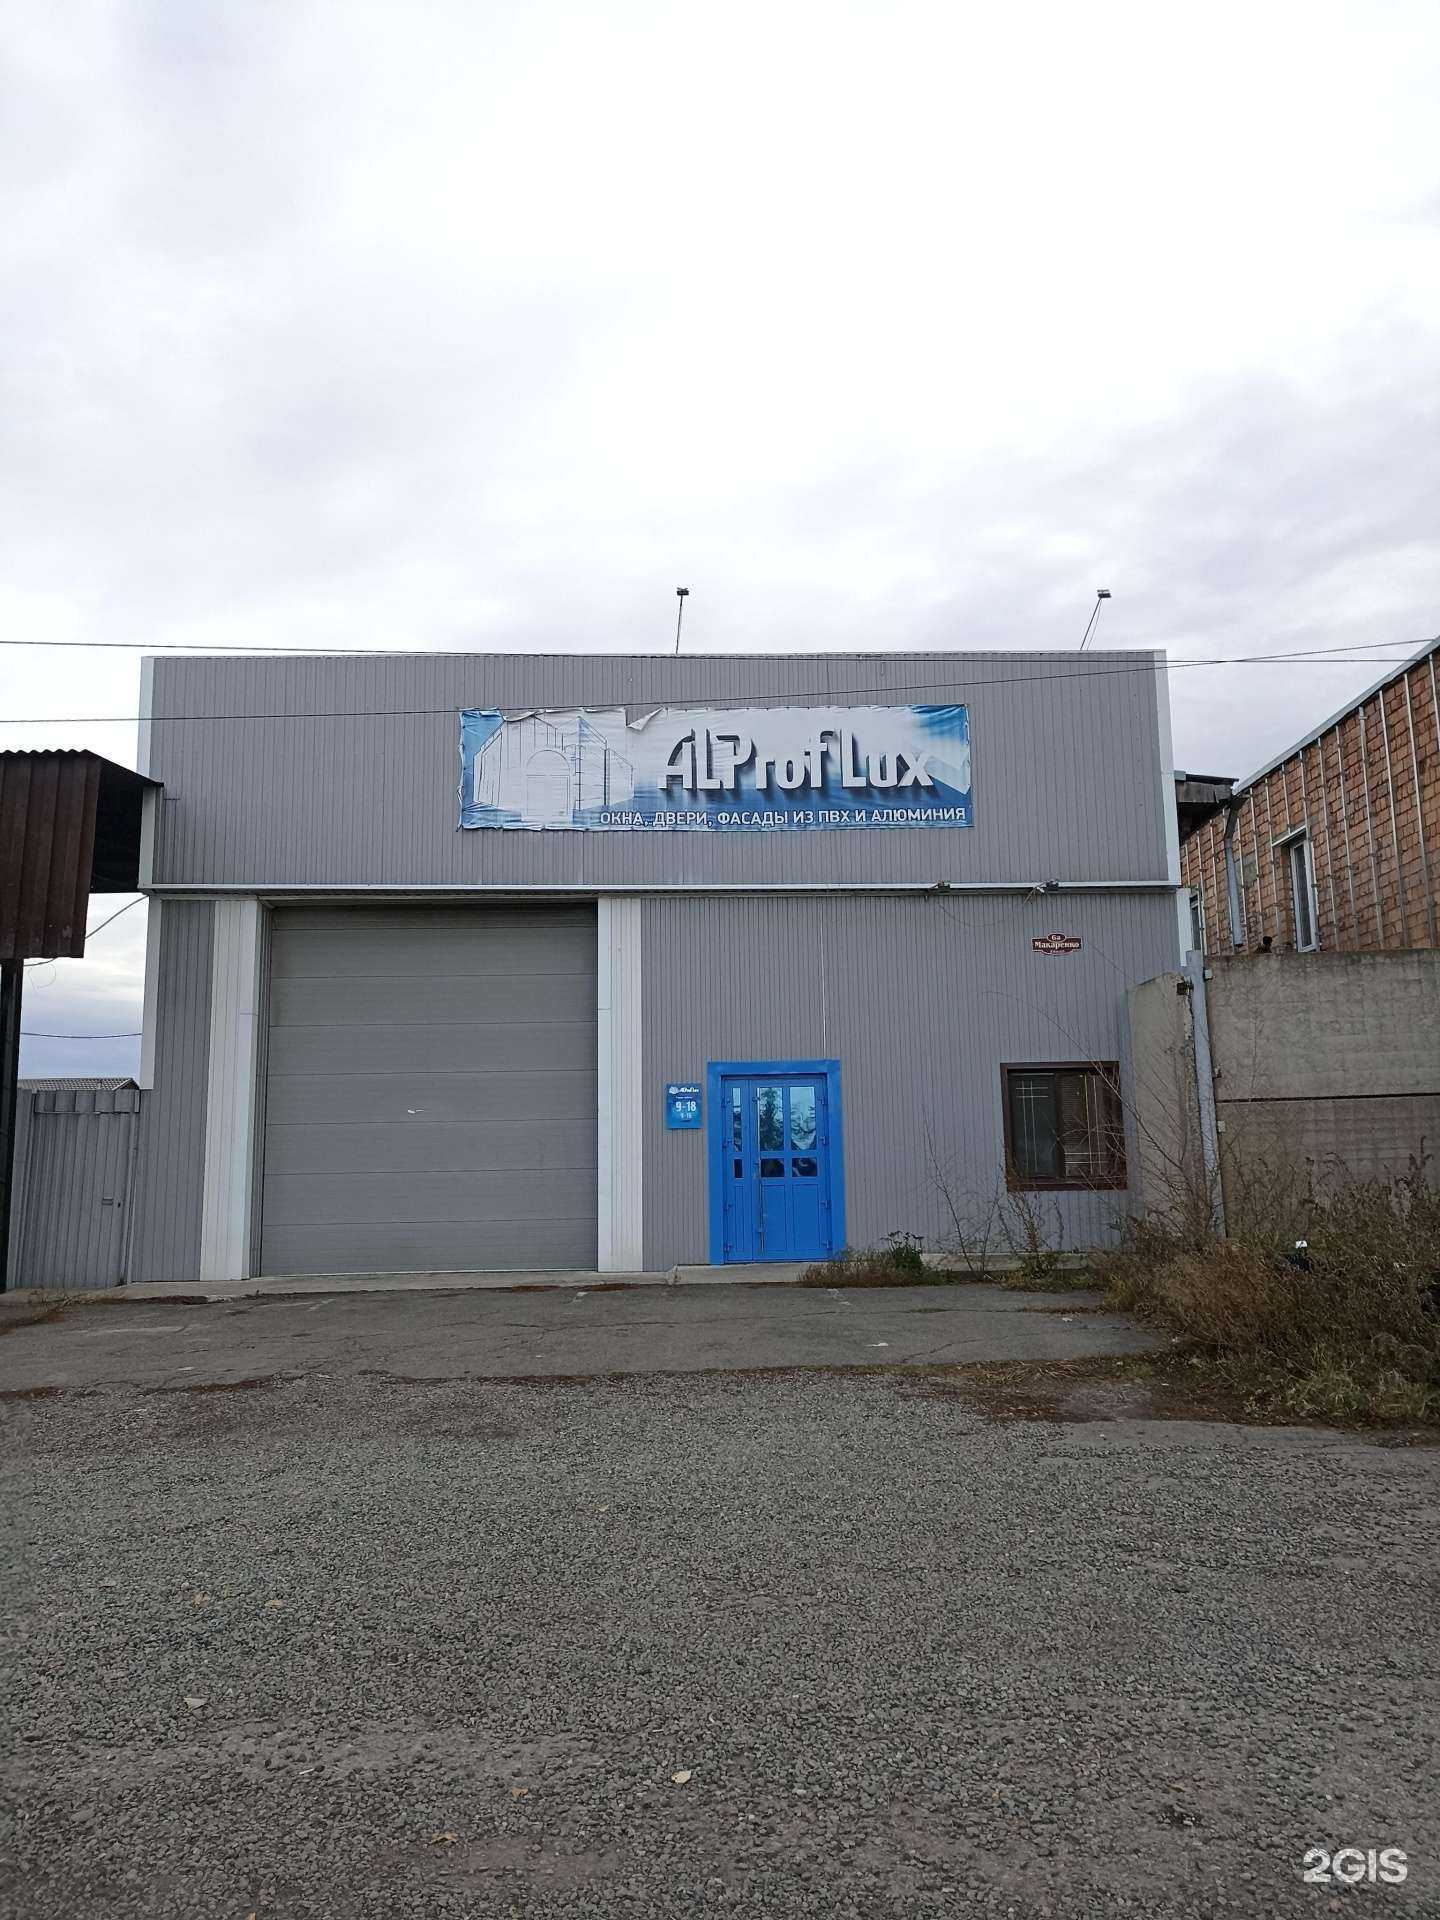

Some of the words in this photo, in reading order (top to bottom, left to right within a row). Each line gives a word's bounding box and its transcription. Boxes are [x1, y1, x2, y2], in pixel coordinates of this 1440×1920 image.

[600, 811, 648, 826] ОКНА,
[652, 811, 712, 827] ДВЕРИ,
[717, 811, 788, 826] ФАСАДЫ
[793, 810, 814, 823] ИЗ
[818, 810, 850, 823] ПВХ
[855, 809, 866, 822] И
[871, 807, 966, 822] АЛЮМИНИЯ
[1034, 941, 1079, 949] Макаренко
